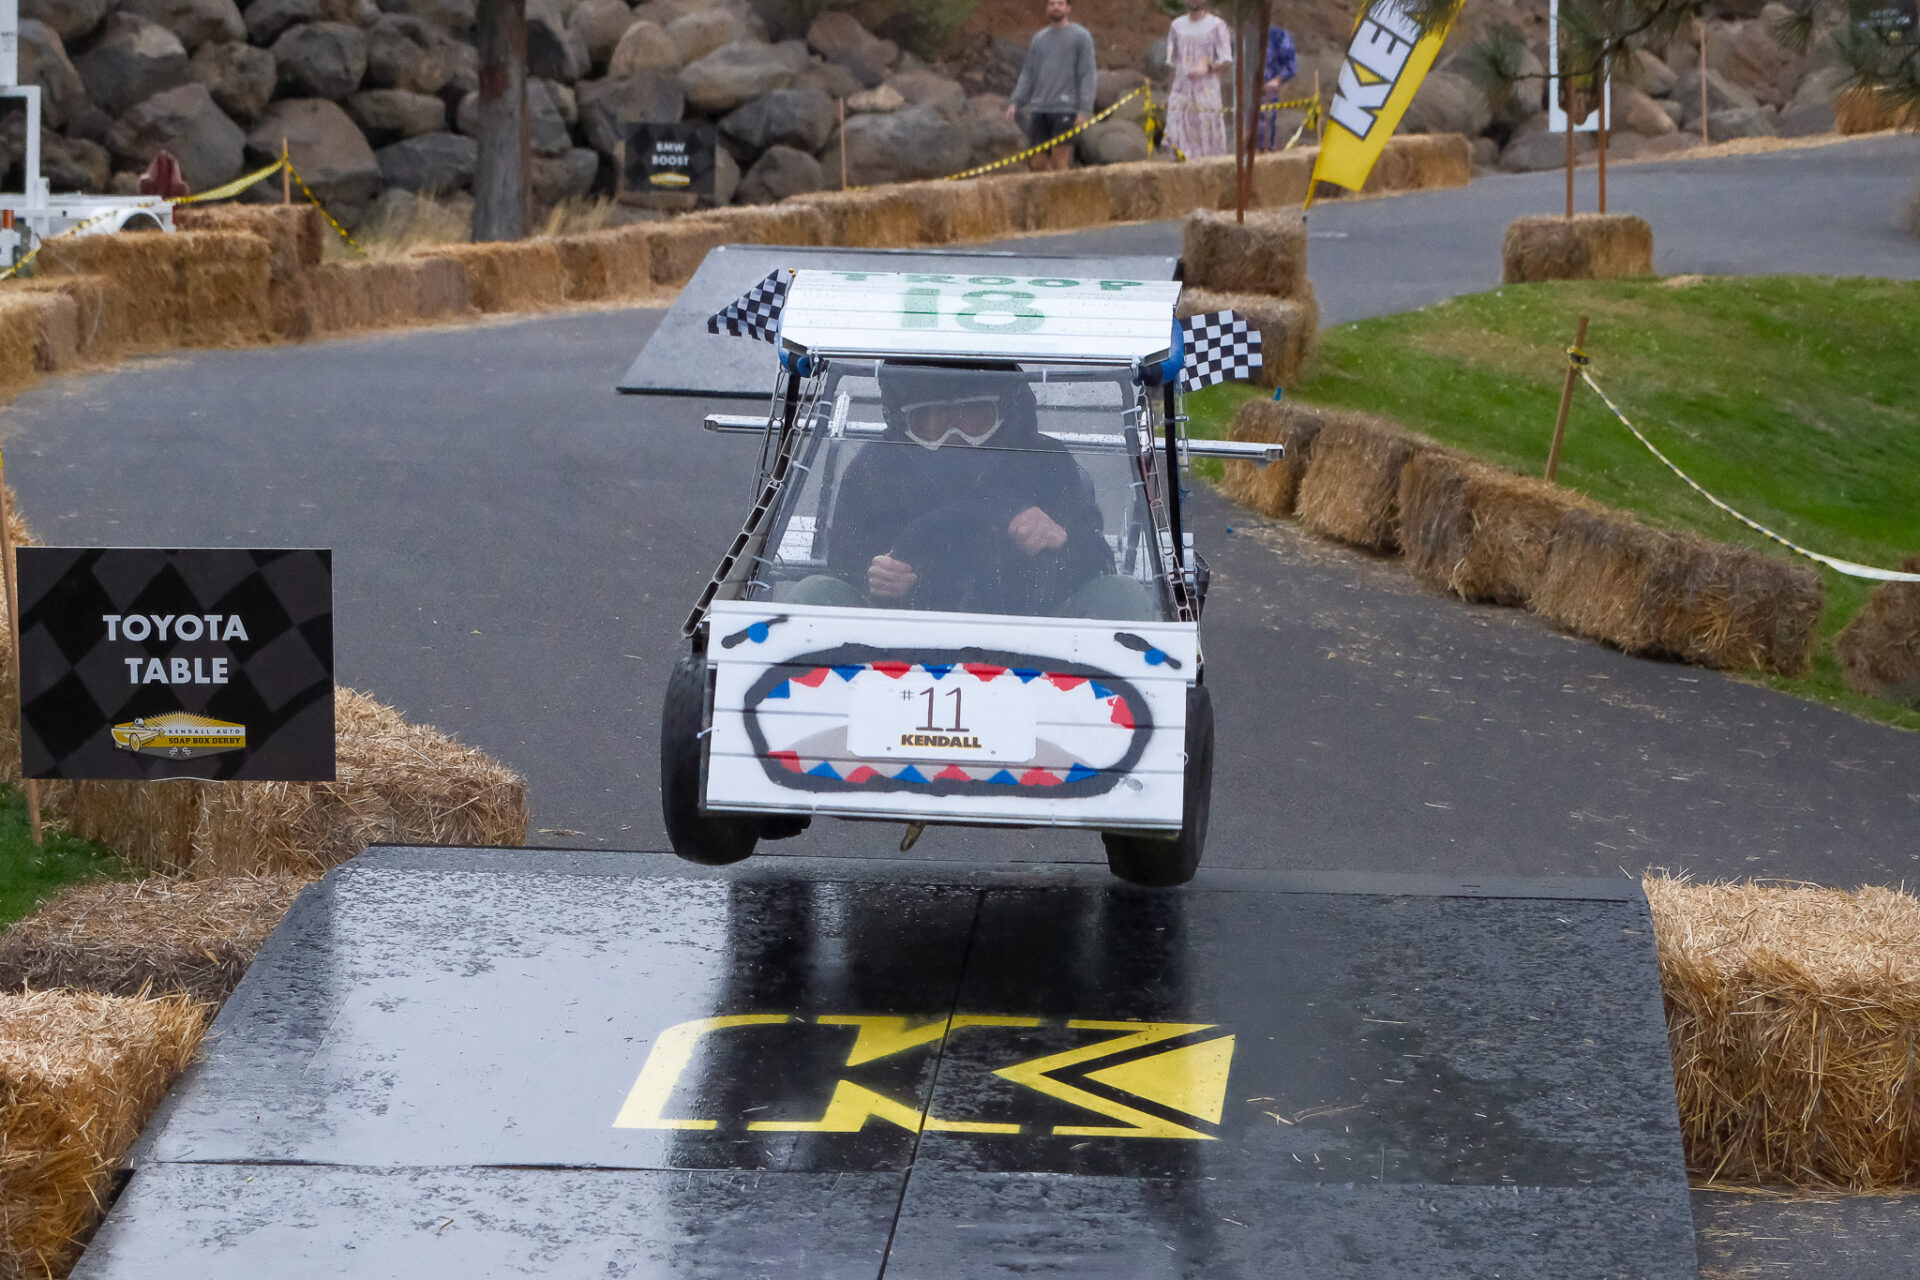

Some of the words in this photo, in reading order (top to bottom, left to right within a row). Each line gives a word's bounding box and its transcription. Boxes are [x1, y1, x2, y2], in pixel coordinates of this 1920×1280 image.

[656, 142, 686, 153] BMW
[651, 155, 690, 166] BOOST
[831, 271, 1142, 291] TROOP
[102, 614, 249, 642] TOYOTA
[124, 657, 229, 684] TABLE
[168, 737, 191, 745] SOAP
[192, 737, 210, 745] BOX
[212, 737, 241, 745] DERBY
[900, 733, 982, 749] KENDALL
